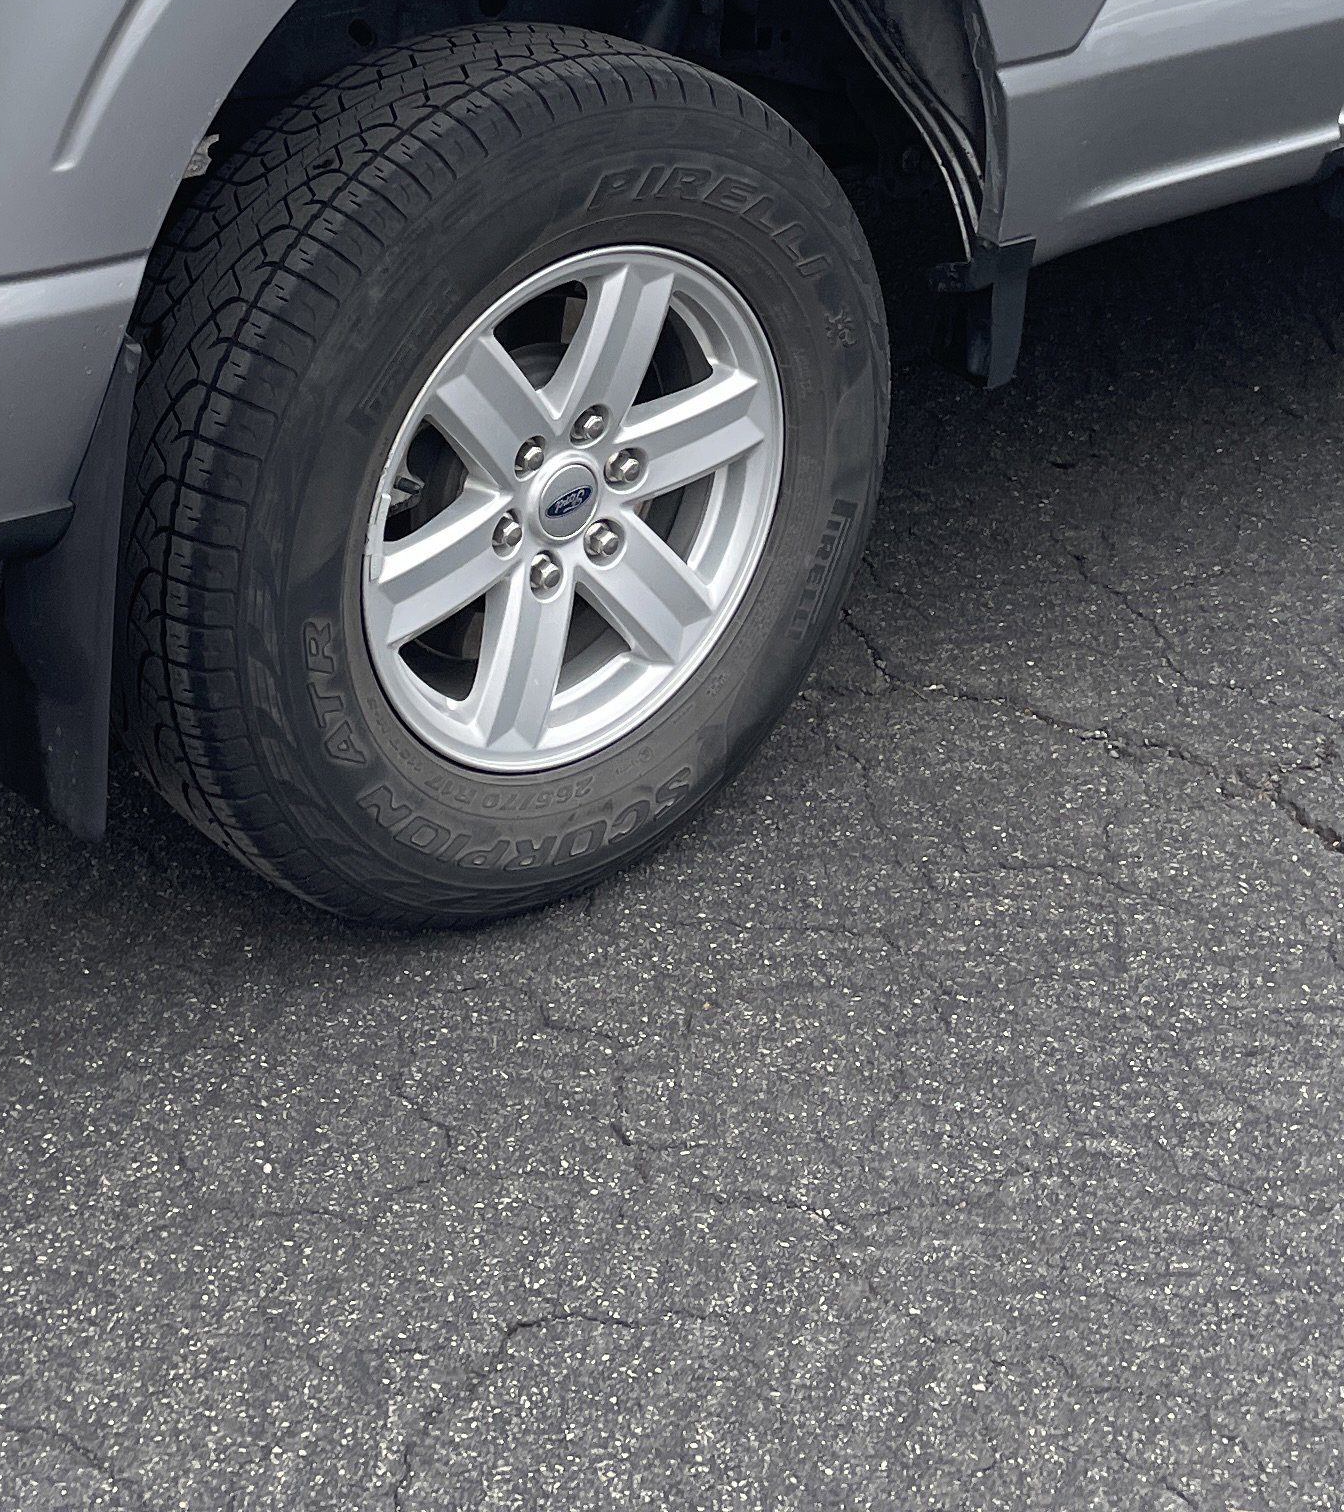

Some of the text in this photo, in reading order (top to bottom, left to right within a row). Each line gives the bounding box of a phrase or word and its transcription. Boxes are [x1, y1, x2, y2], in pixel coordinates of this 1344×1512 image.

[585, 164, 830, 279] PIRELLI
[302, 620, 368, 765] ATR
[356, 766, 692, 873] SCORPION
[481, 775, 595, 813] 265/70
